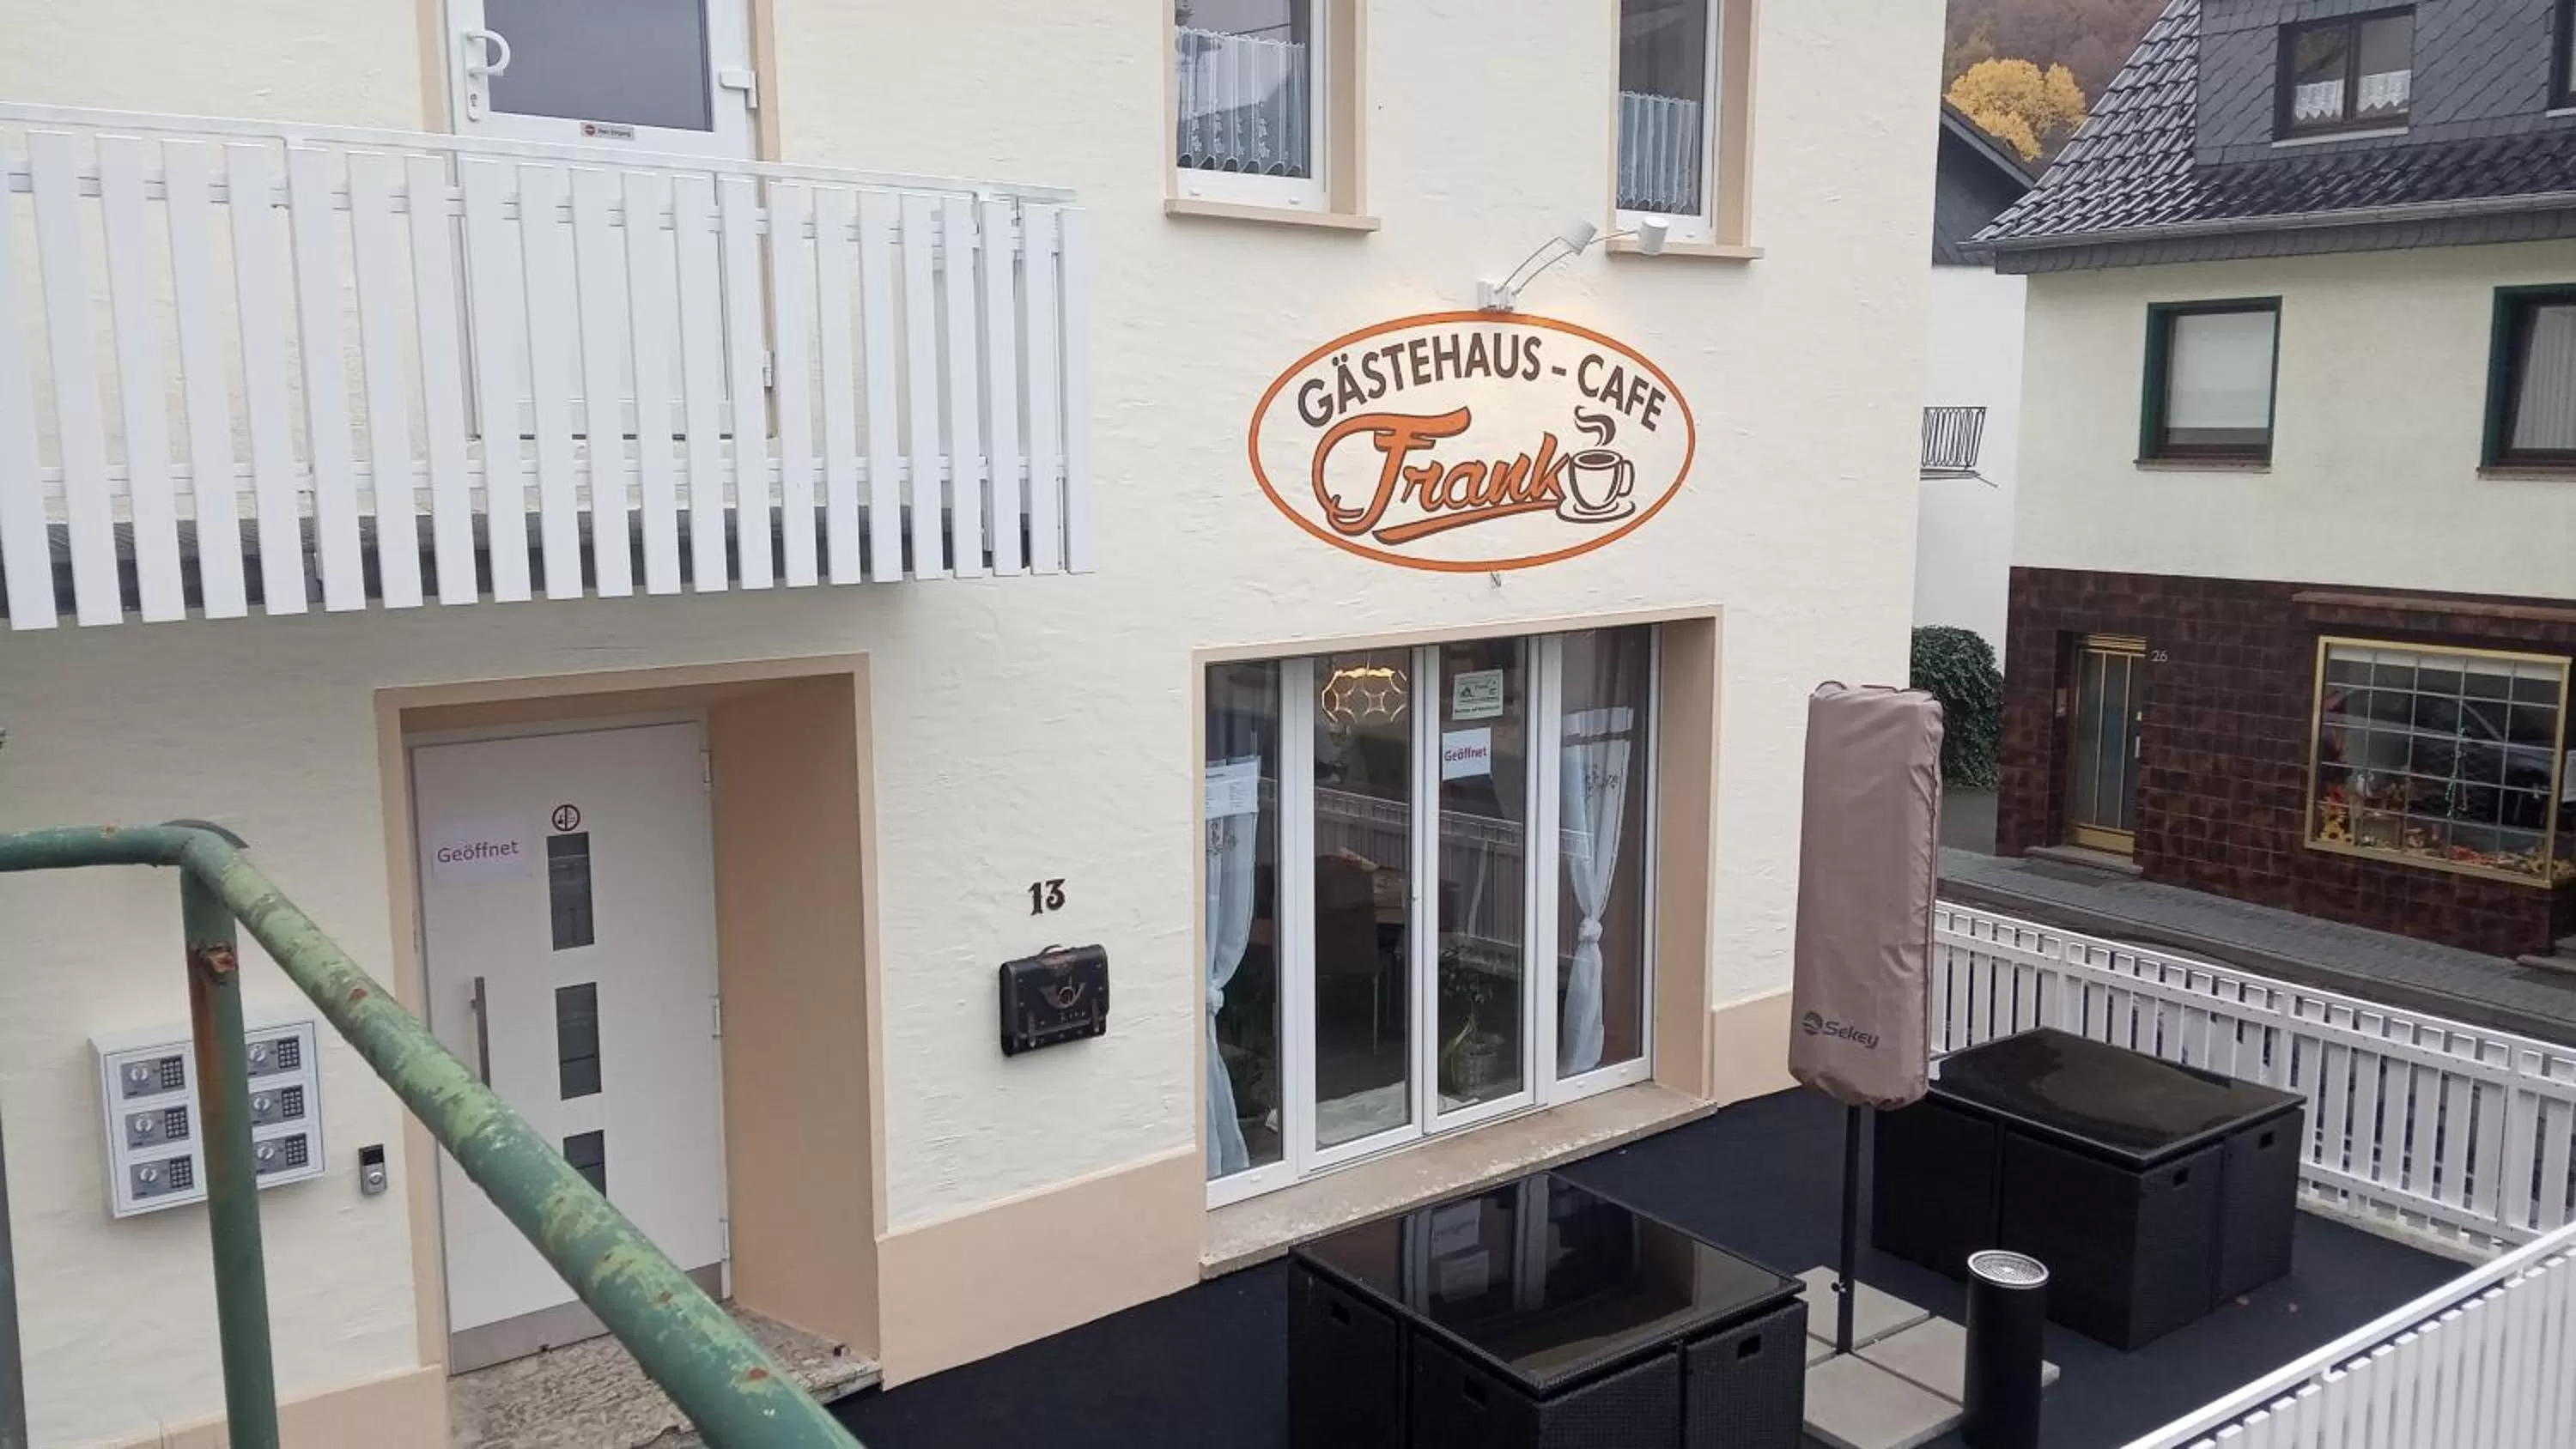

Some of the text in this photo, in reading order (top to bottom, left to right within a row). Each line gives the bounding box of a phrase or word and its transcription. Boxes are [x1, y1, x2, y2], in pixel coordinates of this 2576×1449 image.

[1297, 332, 1542, 428] GÄSTEHAUS
[1577, 354, 1668, 432] CAFE
[1312, 406, 1571, 537] Frank
[2150, 650, 2169, 663] 26
[1444, 747, 1487, 761] Geöffnet
[437, 840, 519, 863] Geöffnet
[1028, 878, 1066, 916] 13
[1822, 1020, 1880, 1050] Sekey
